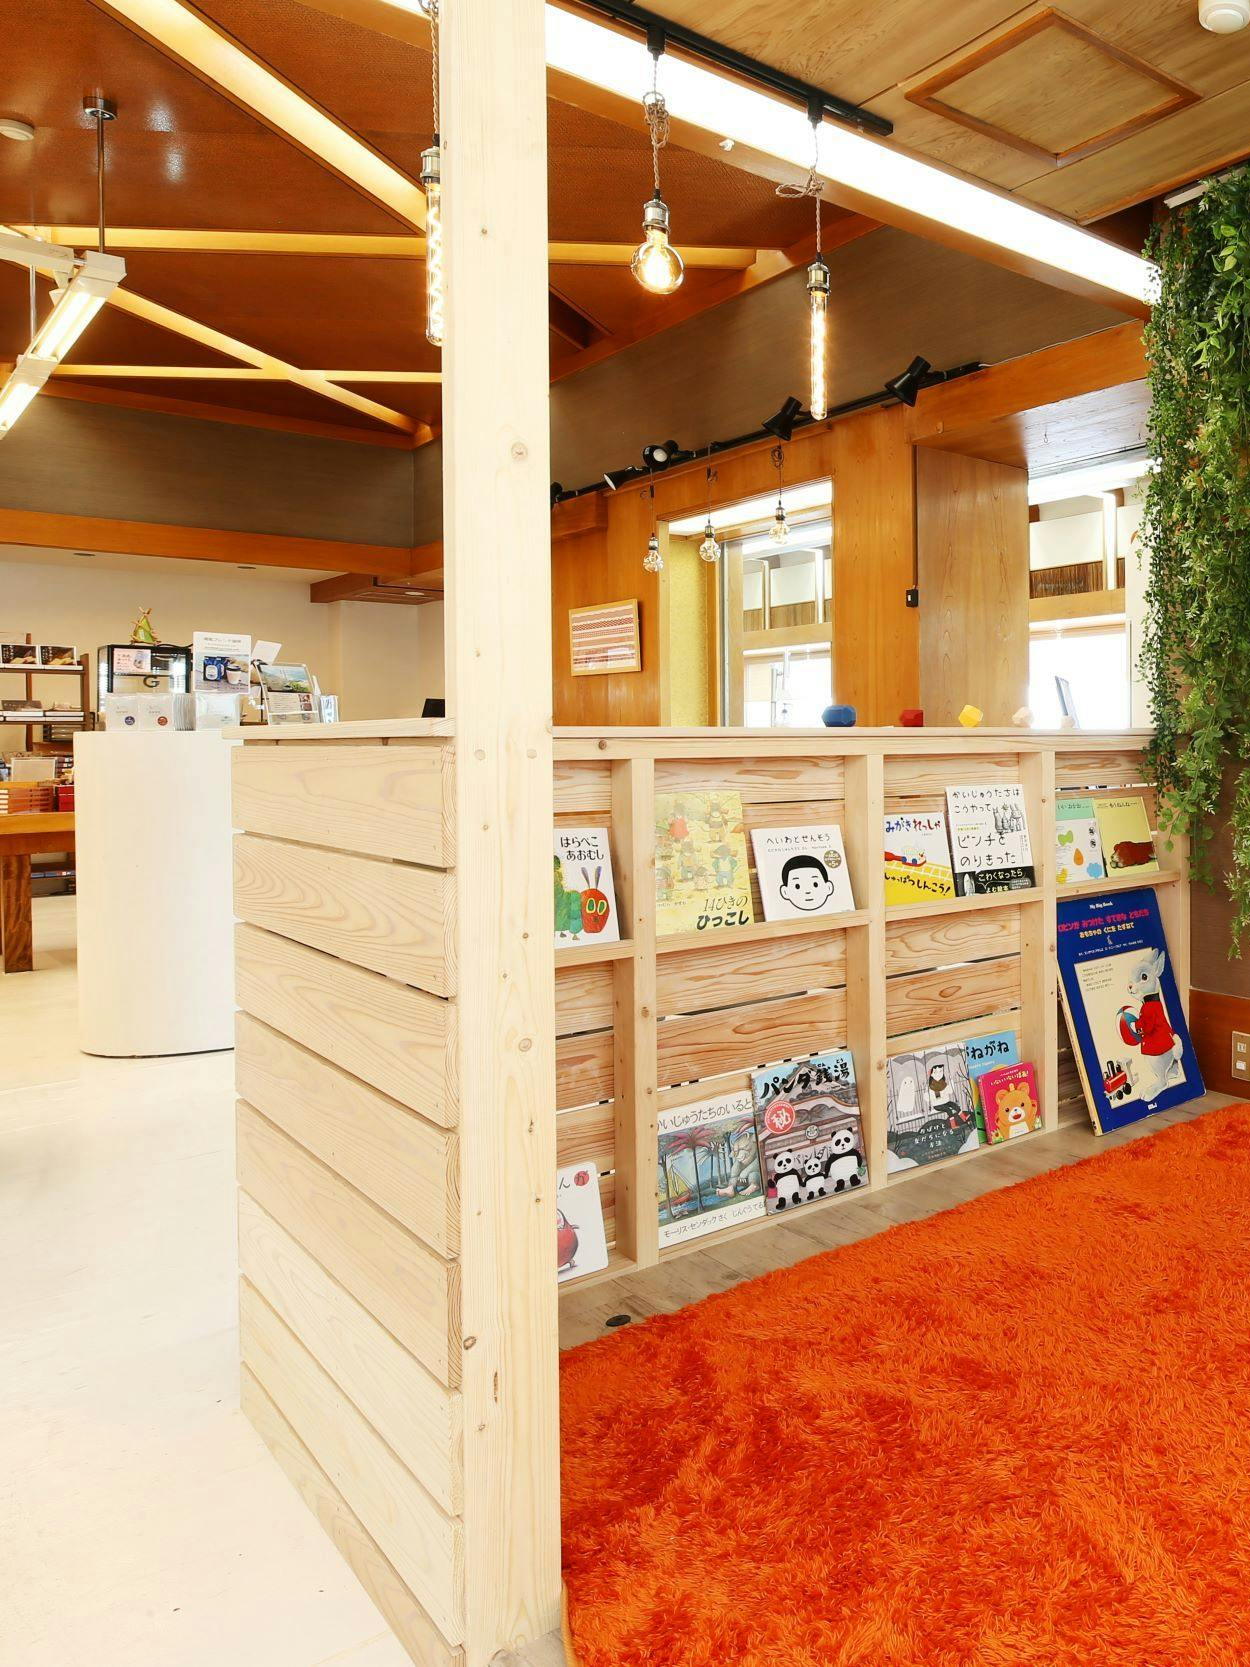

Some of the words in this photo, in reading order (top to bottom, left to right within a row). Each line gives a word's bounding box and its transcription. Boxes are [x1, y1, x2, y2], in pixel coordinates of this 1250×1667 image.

[143, 675, 160, 688] G
[952, 788, 1020, 799] かいじゅうたちは
[954, 803, 991, 814] こうやって
[560, 836, 599, 848] はらぺこ
[766, 833, 831, 845] へいわとせんそう
[957, 831, 1006, 849] ピンチを
[566, 849, 605, 861] あおむし
[960, 851, 1016, 868] のりきった
[978, 868, 1023, 881] こわくなったら
[703, 895, 748, 912] 14ひきの
[696, 910, 750, 930] ひっこし
[760, 1062, 850, 1099] パンダ銭湯
[771, 1108, 792, 1130] 秘
